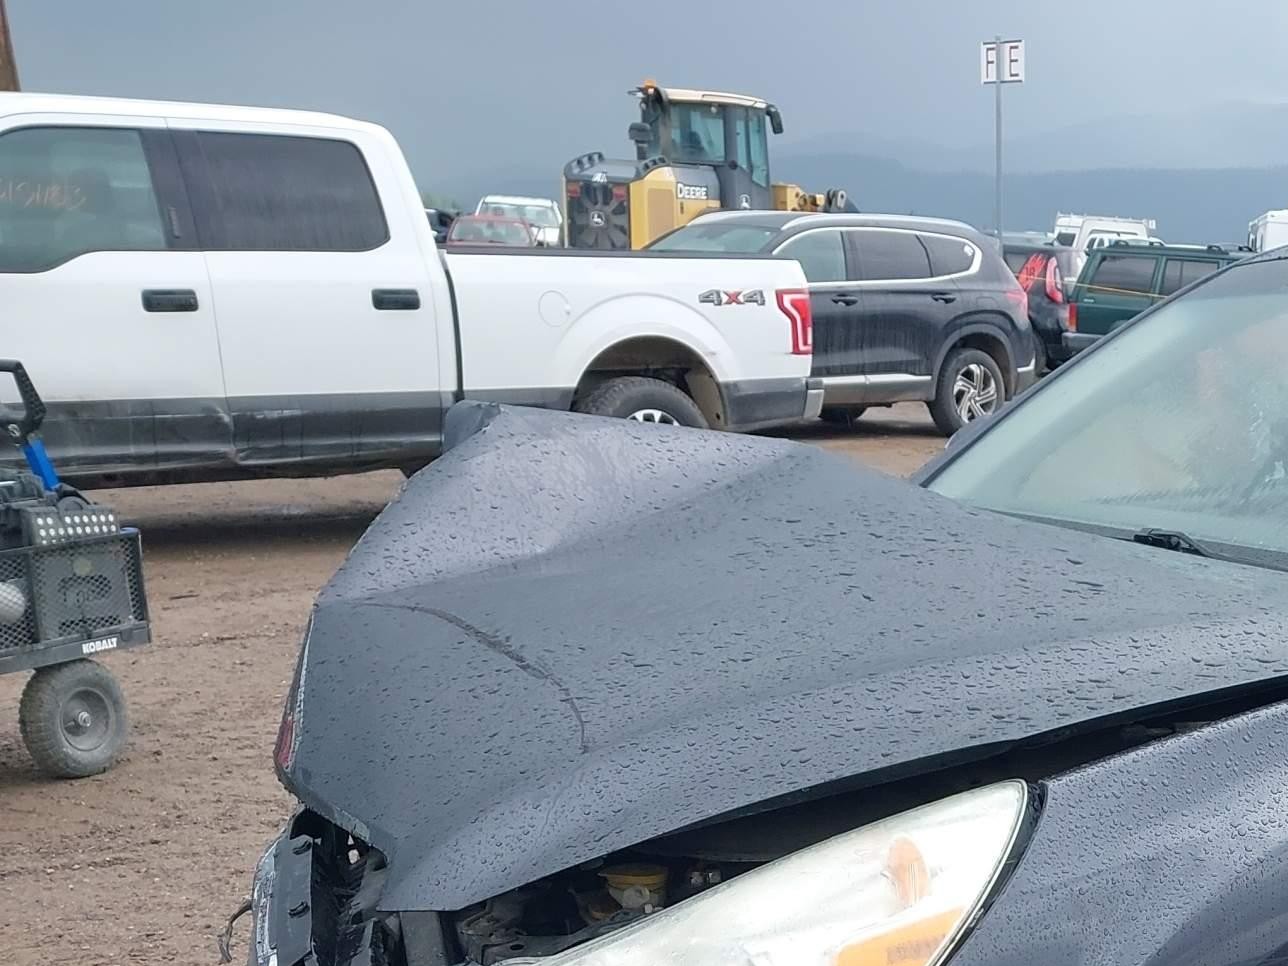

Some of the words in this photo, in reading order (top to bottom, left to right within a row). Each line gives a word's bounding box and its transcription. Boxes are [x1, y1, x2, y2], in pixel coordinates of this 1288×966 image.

[985, 47, 996, 80] F
[1008, 45, 1020, 78] E
[677, 182, 708, 200] DEERE
[81, 637, 118, 655] KOBALT
